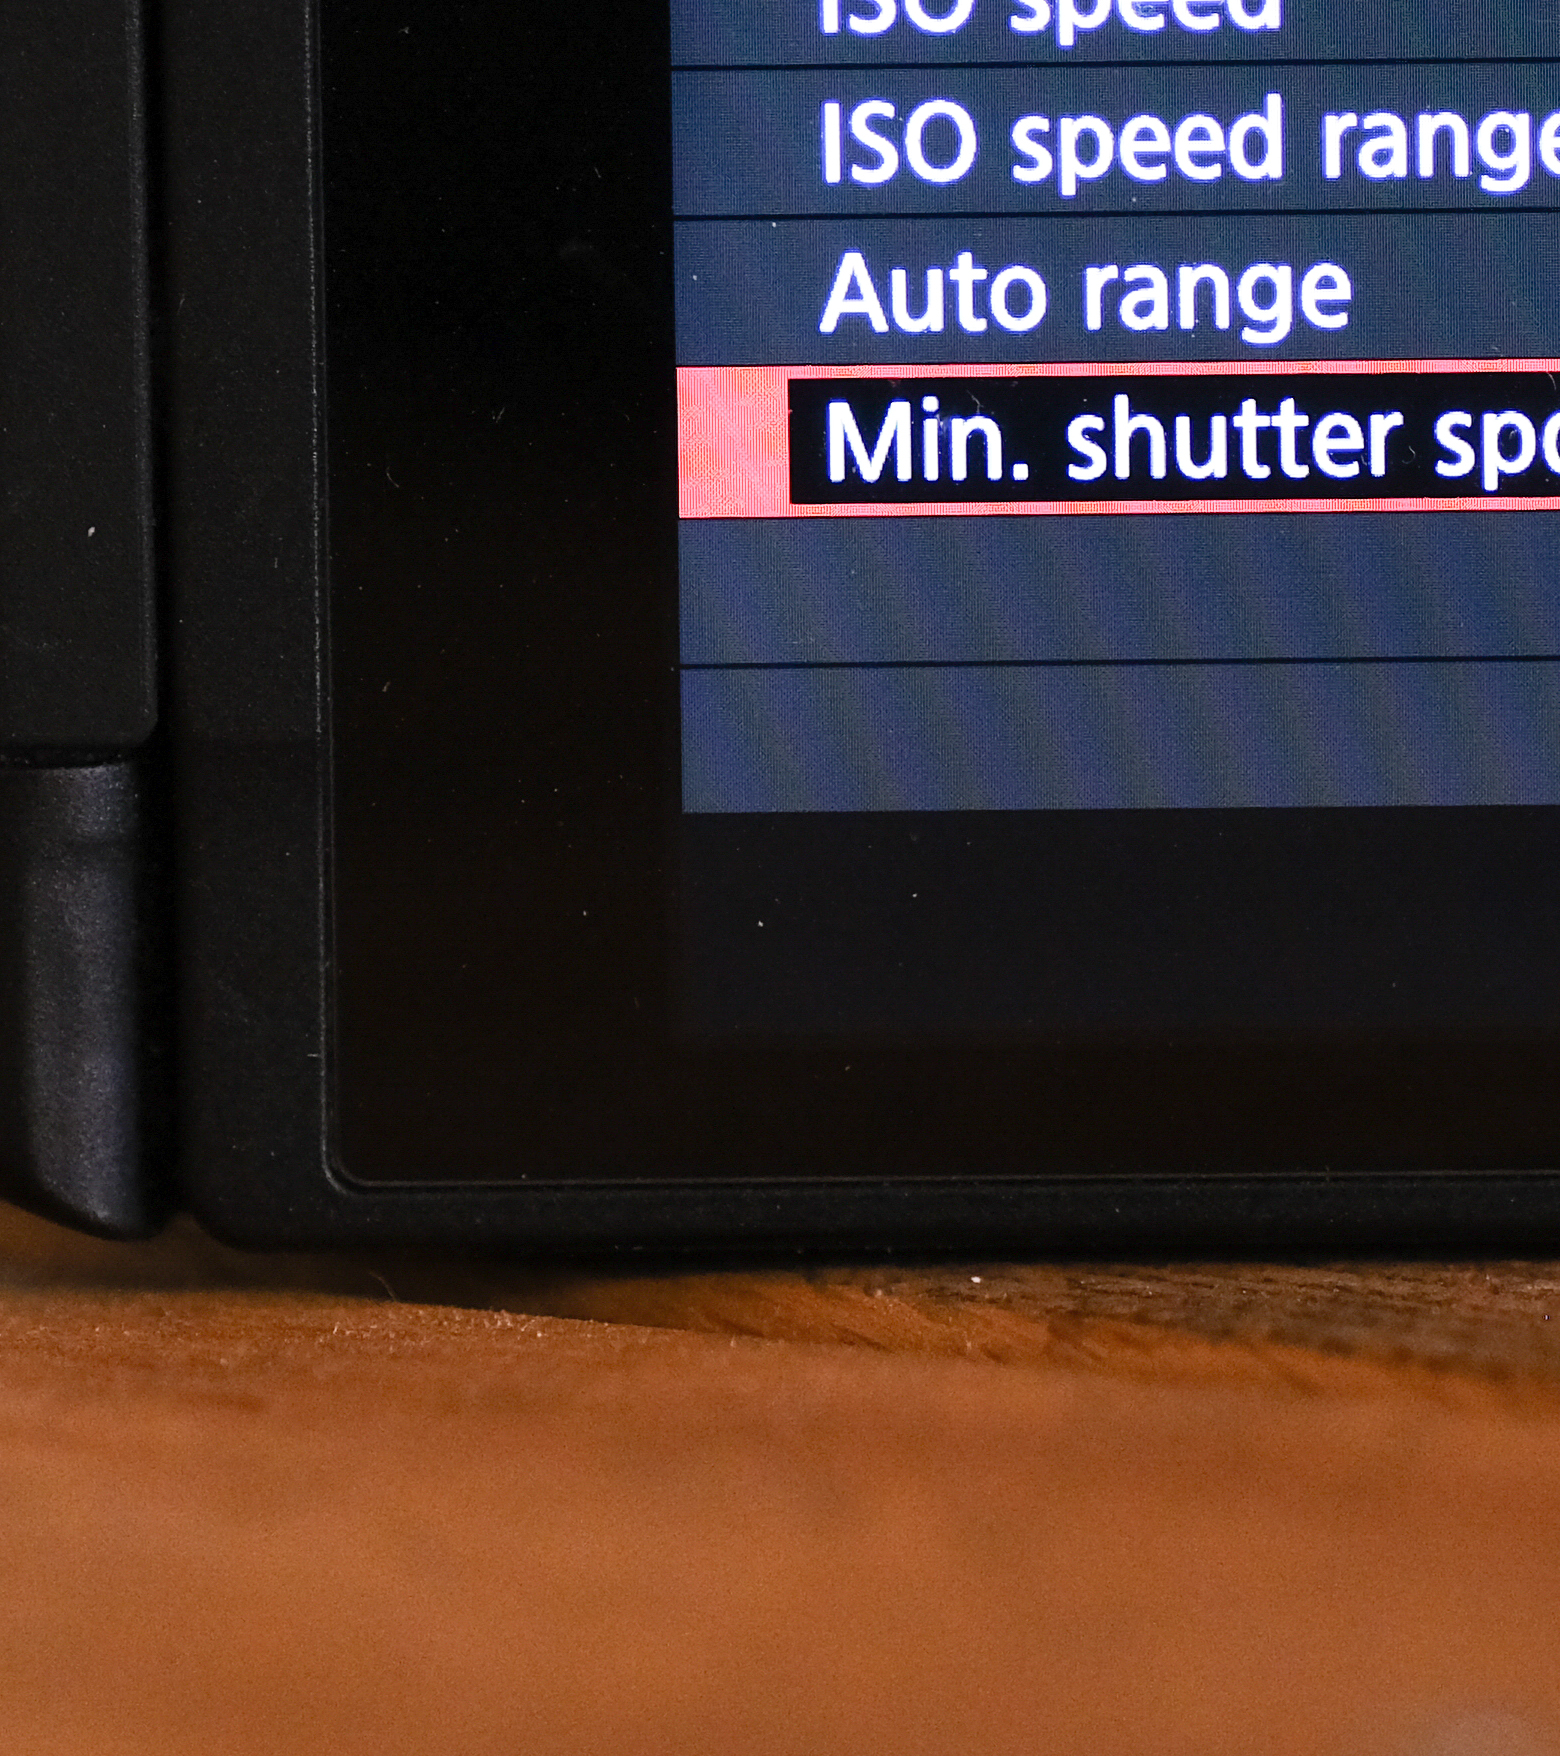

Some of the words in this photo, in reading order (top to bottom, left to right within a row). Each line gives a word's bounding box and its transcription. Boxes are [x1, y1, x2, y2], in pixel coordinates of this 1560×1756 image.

[823, 99, 977, 184] ISO
[1011, 92, 1283, 197] speed
[819, 251, 1047, 333] Auto
[1085, 262, 1352, 345] range
[828, 395, 1029, 484] Min.
[1067, 393, 1404, 481] shutter
